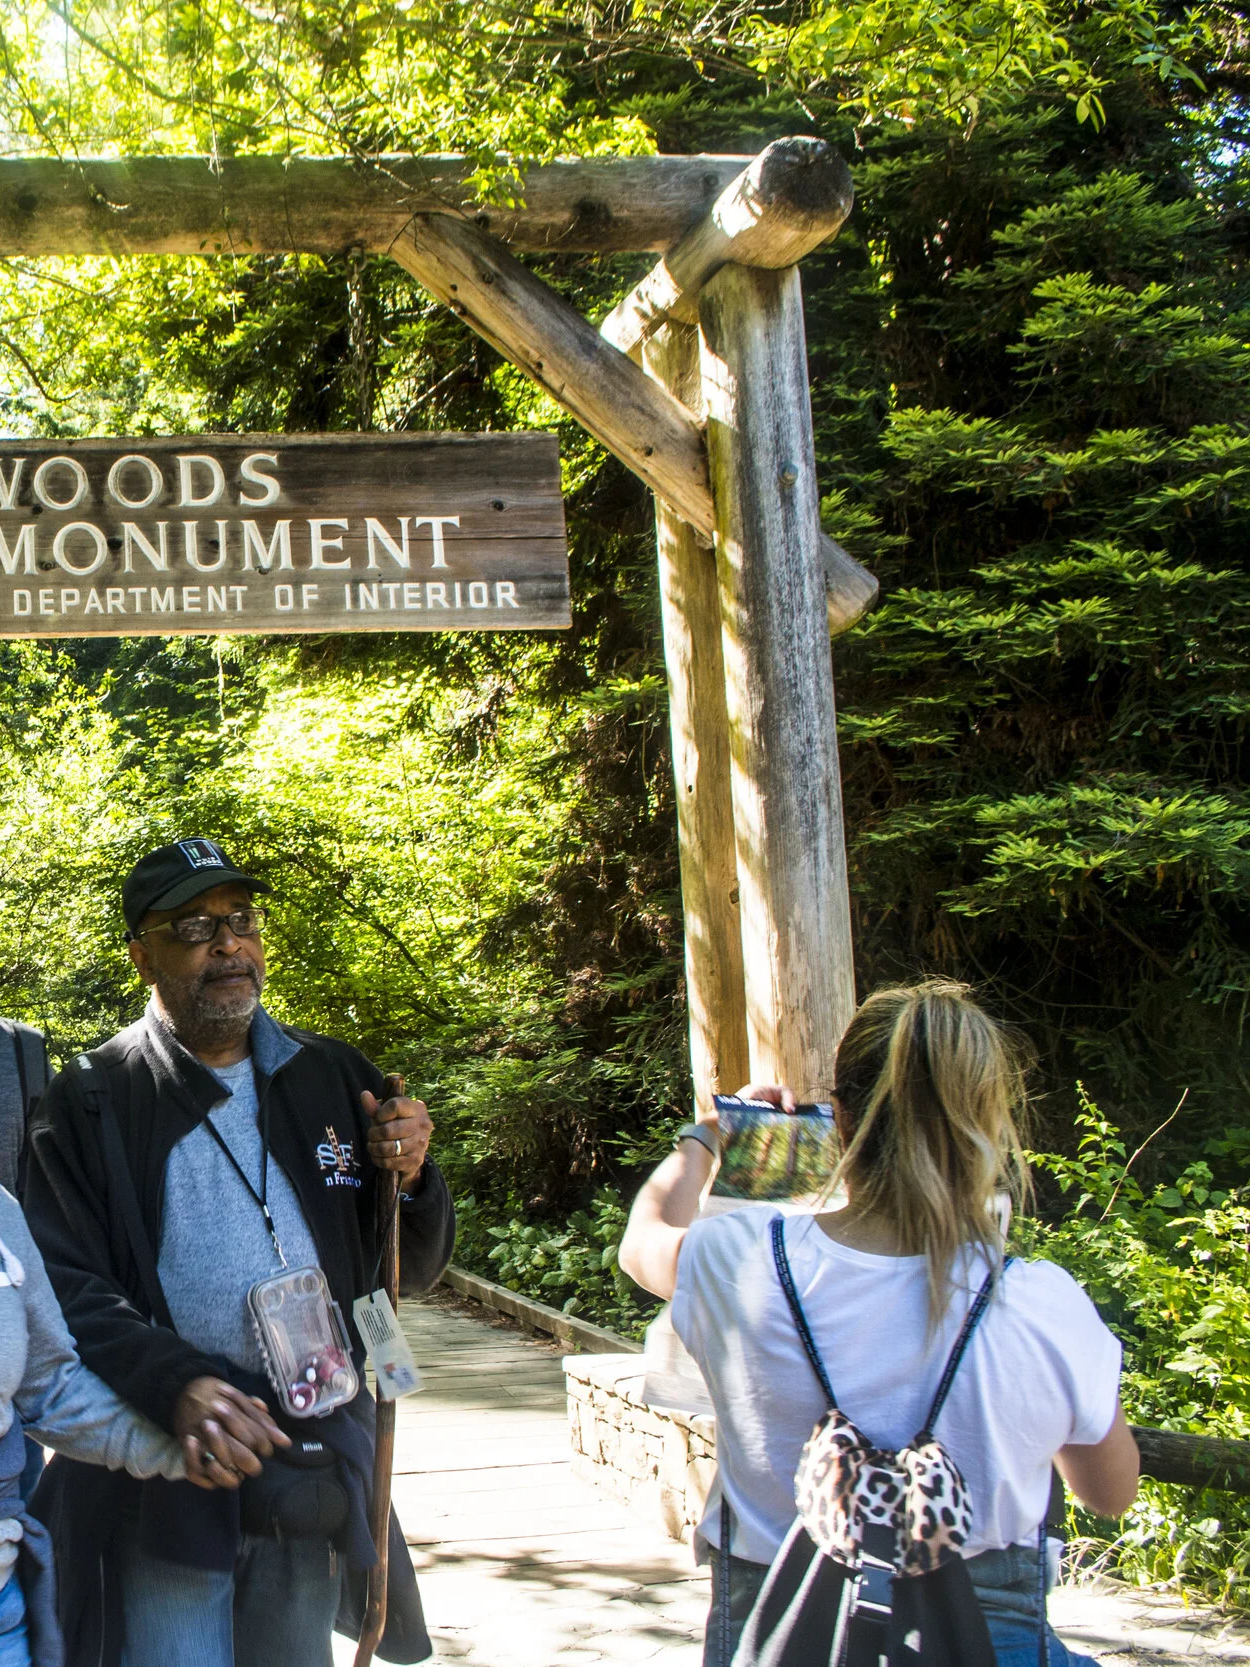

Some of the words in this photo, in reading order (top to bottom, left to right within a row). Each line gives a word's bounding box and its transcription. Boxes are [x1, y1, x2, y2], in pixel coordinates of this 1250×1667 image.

[13, 585, 248, 616] DEPARTMENT
[275, 583, 319, 612] OF
[345, 581, 520, 610] INTERIOR
